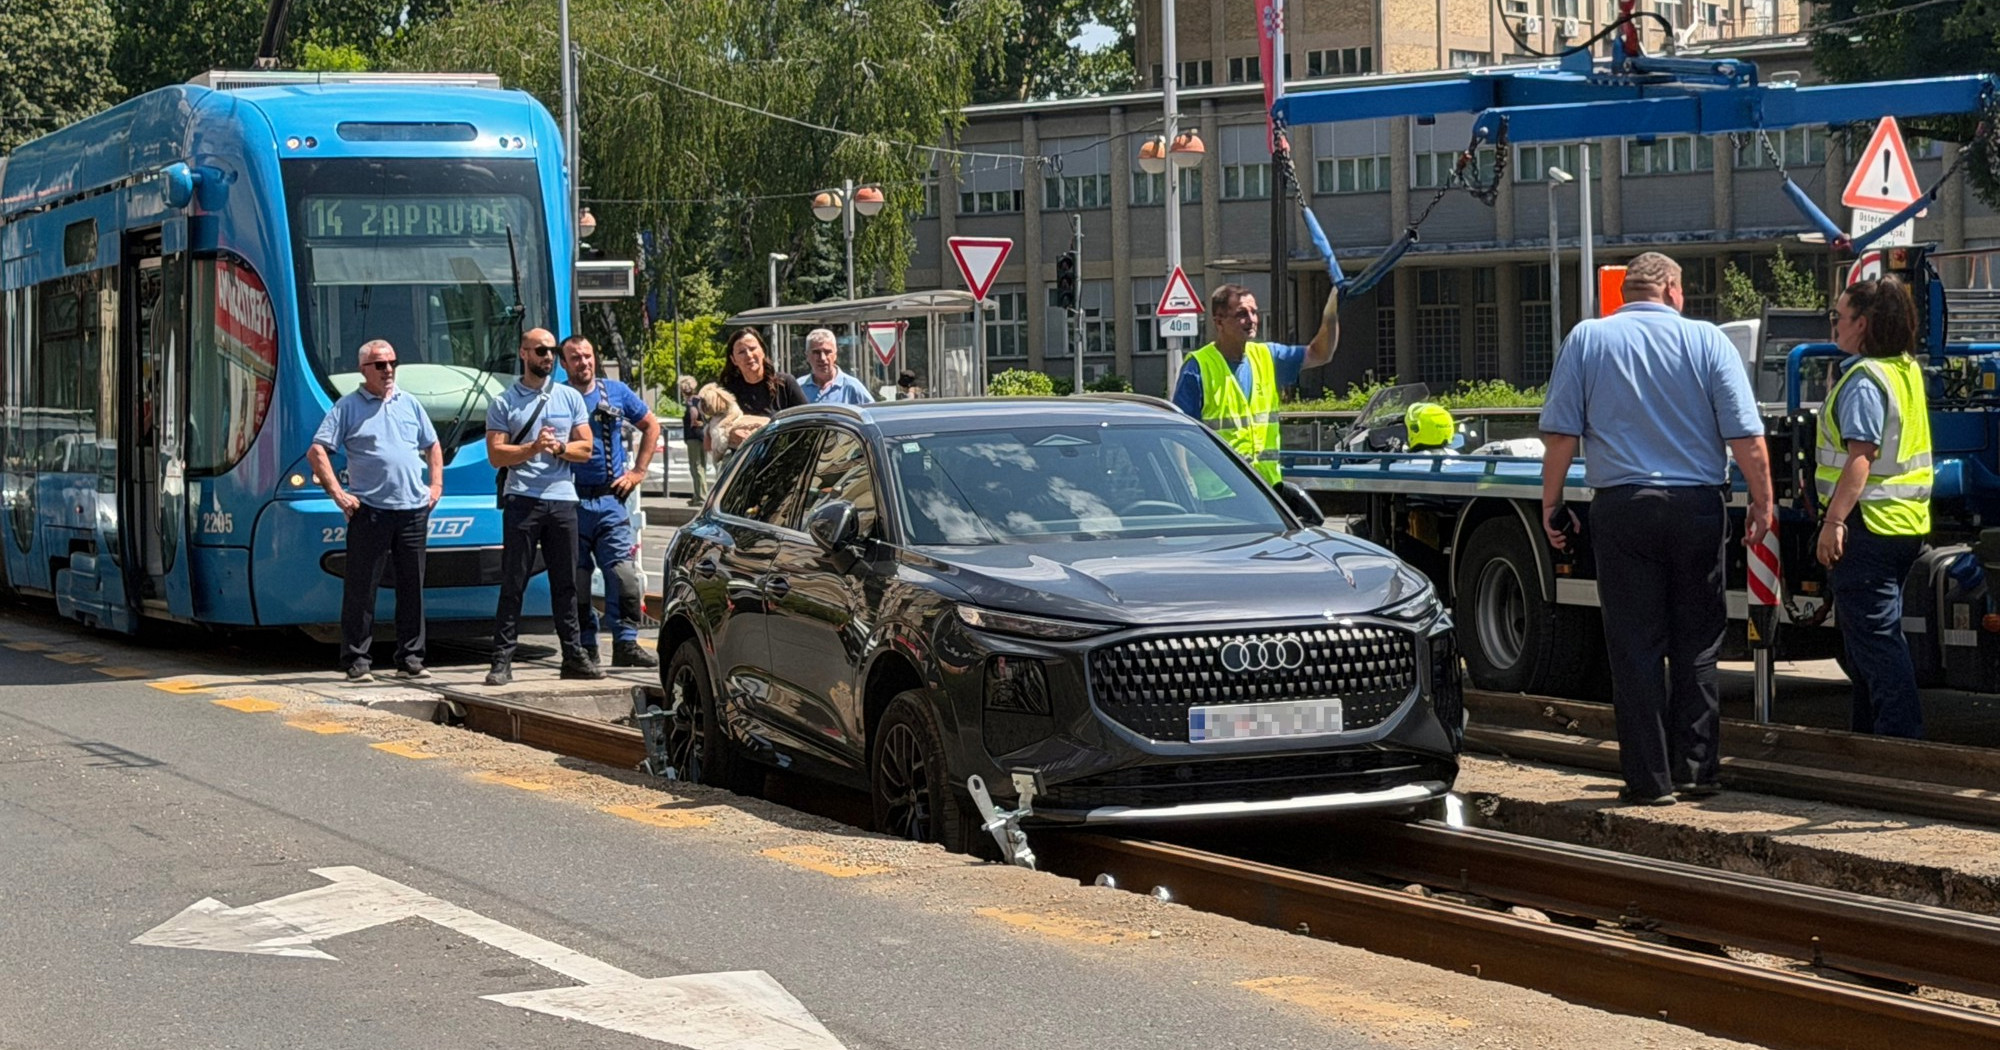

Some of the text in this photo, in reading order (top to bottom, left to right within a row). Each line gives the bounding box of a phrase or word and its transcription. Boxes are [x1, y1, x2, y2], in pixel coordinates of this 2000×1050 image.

[312, 199, 343, 236] 14
[1169, 319, 1191, 331] 40m
[203, 512, 233, 534] 2205
[322, 527, 347, 543] 22
